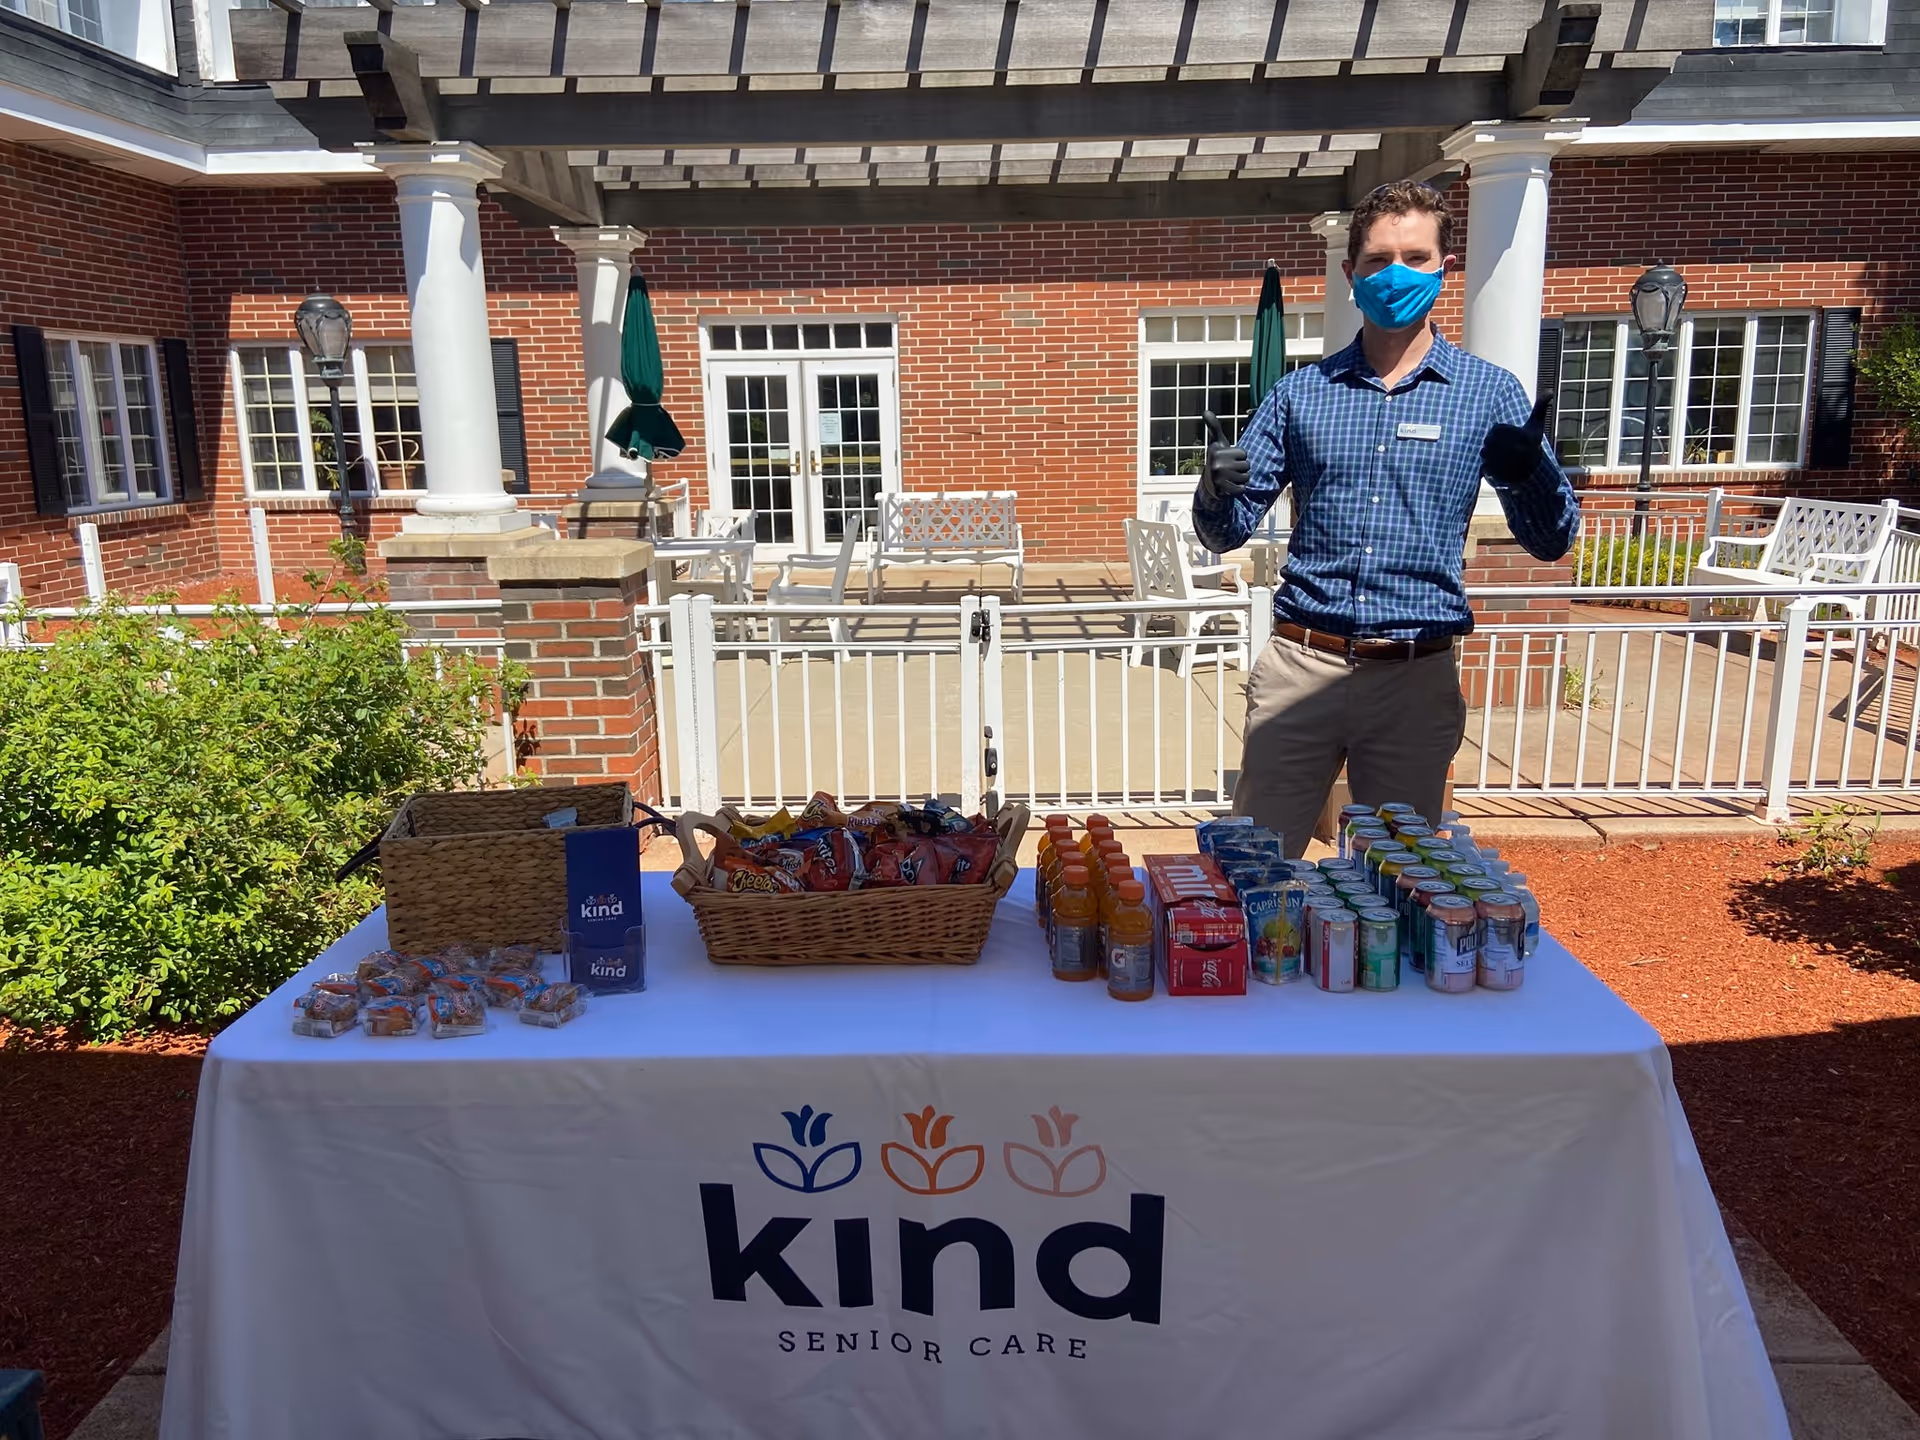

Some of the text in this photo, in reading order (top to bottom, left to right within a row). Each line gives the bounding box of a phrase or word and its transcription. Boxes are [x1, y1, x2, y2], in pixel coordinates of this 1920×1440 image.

[581, 901, 623, 918] kind
[590, 963, 627, 978] kind
[699, 1182, 1165, 1325] kind
[779, 1329, 1088, 1364] SENIOR CARE
